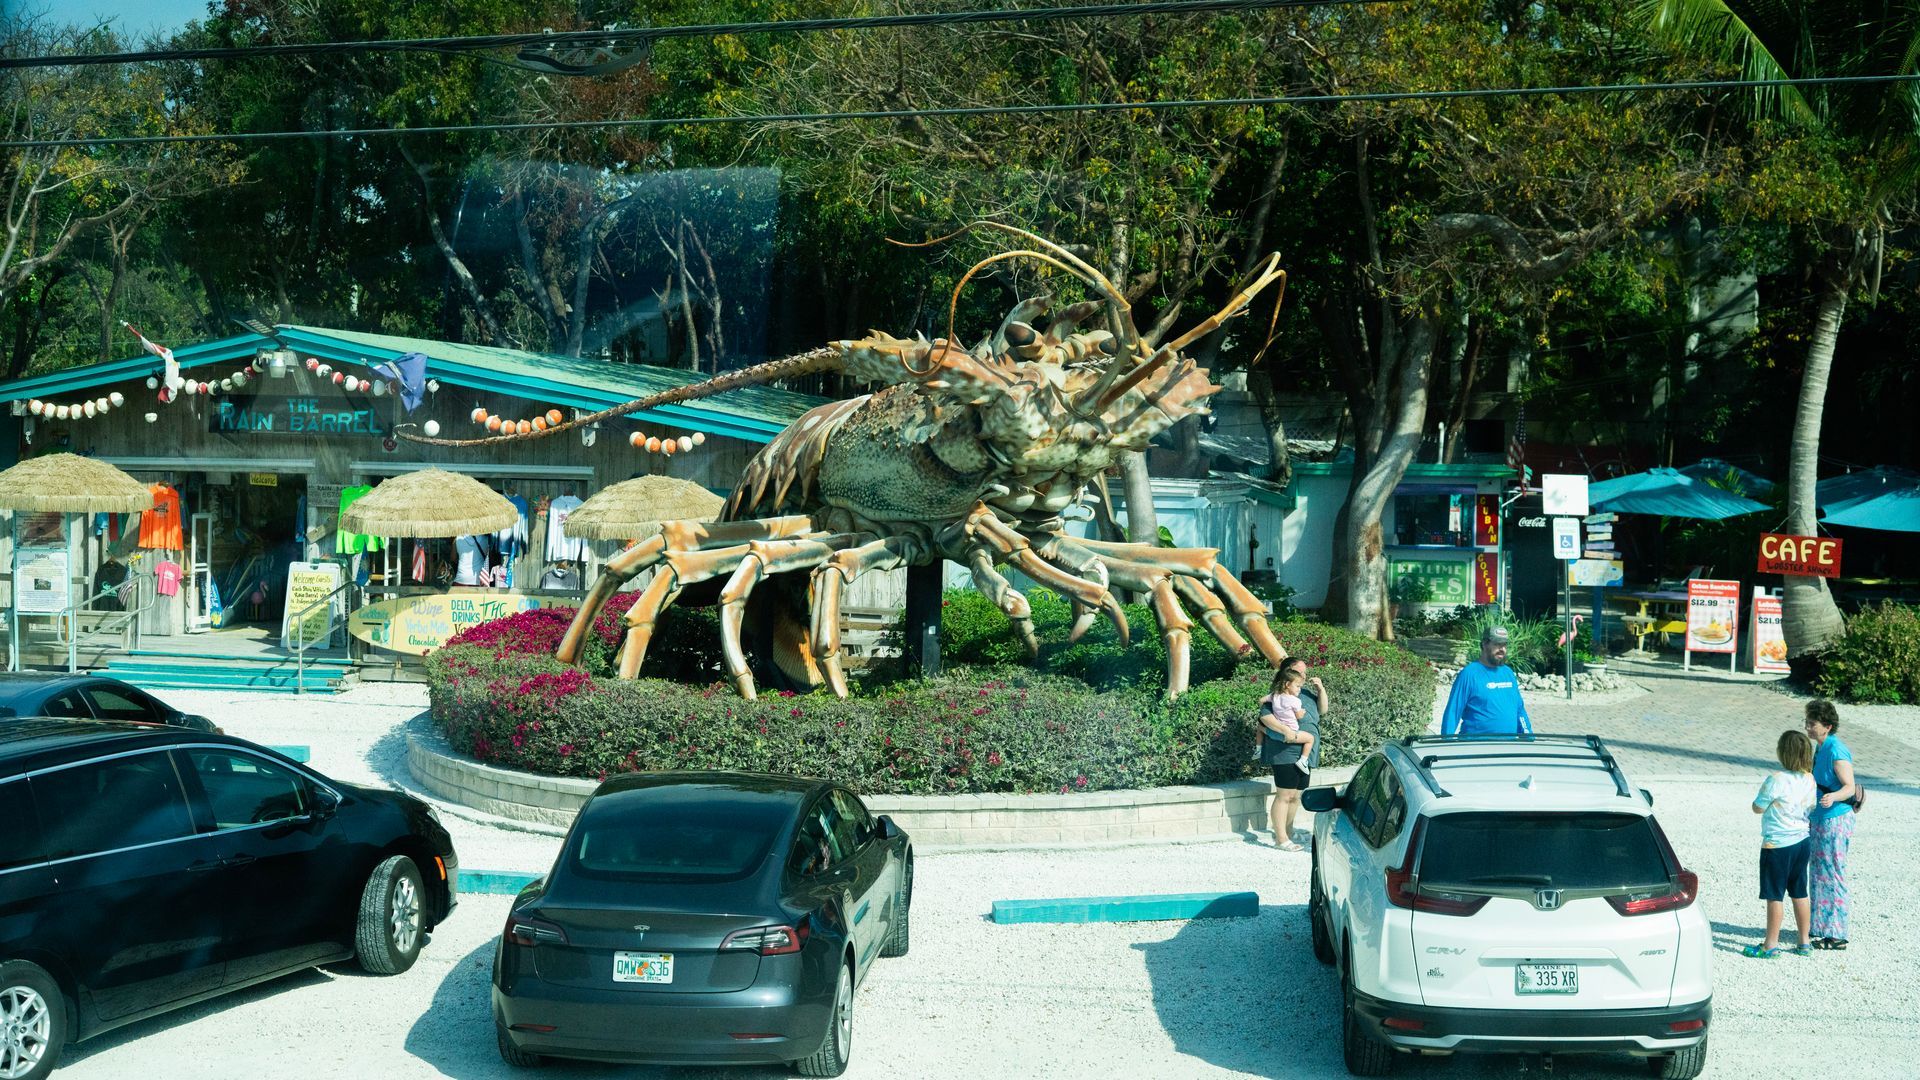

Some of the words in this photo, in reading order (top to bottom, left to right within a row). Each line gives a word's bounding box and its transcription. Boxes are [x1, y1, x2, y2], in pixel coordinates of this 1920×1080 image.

[287, 398, 319, 413] THE
[219, 402, 273, 431] RAIN
[289, 408, 383, 433] BARREL
[1480, 496, 1497, 543] CUBAN
[1761, 536, 1836, 564] CAFE
[1766, 561, 1803, 573] LOBSTER
[292, 573, 315, 585] Welcome
[1477, 553, 1496, 603] COFFEE
[410, 599, 443, 617] Wine
[451, 599, 474, 612] DELTA
[480, 600, 507, 619] THC
[1691, 599, 1718, 607] $12.99
[452, 612, 481, 624] DRINKS
[408, 634, 440, 648] Chocolate
[1425, 946, 1466, 955] CR-V
[1638, 948, 1666, 957] AWD
[1536, 971, 1558, 986] 335
[1562, 971, 1576, 986] XR
